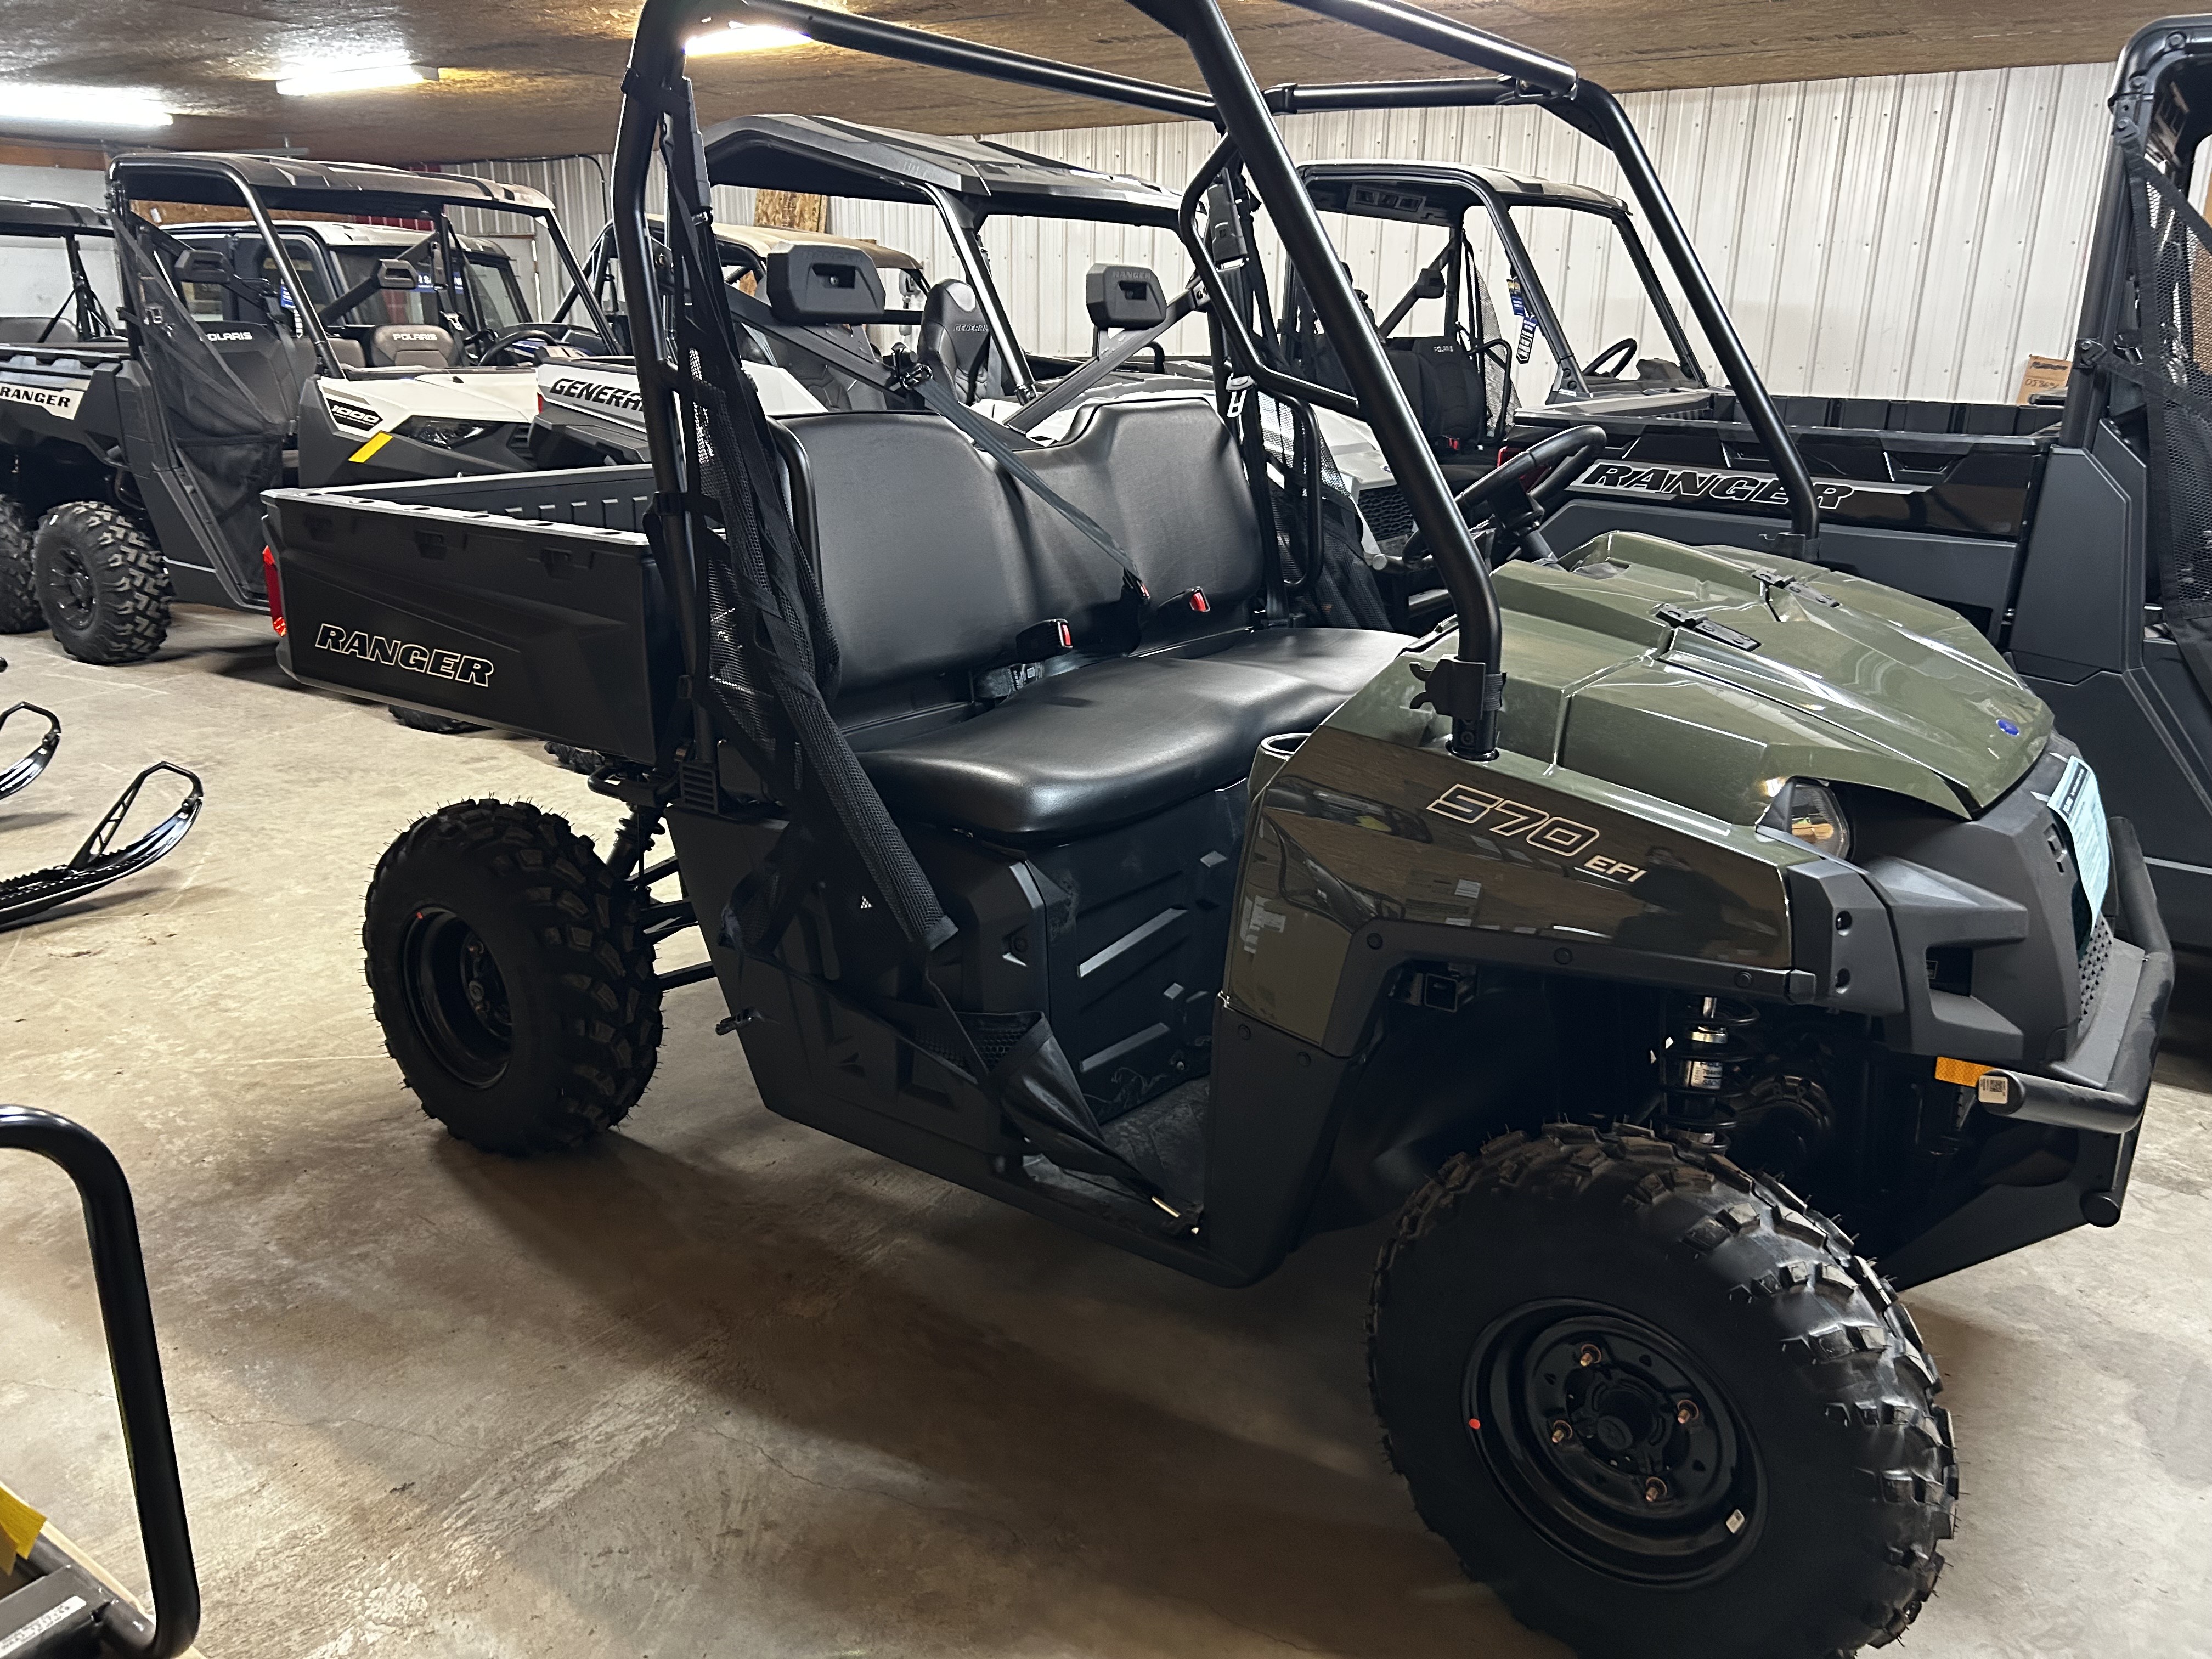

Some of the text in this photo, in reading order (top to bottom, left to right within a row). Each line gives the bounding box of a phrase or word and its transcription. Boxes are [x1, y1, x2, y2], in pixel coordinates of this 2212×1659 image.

[1114, 271, 1151, 279] RANGER
[0, 387, 71, 408] RANGER
[550, 378, 643, 411] GENERA
[331, 405, 380, 424] 1000
[315, 623, 494, 687] RANGER
[1426, 783, 1647, 882] 570 EFI
